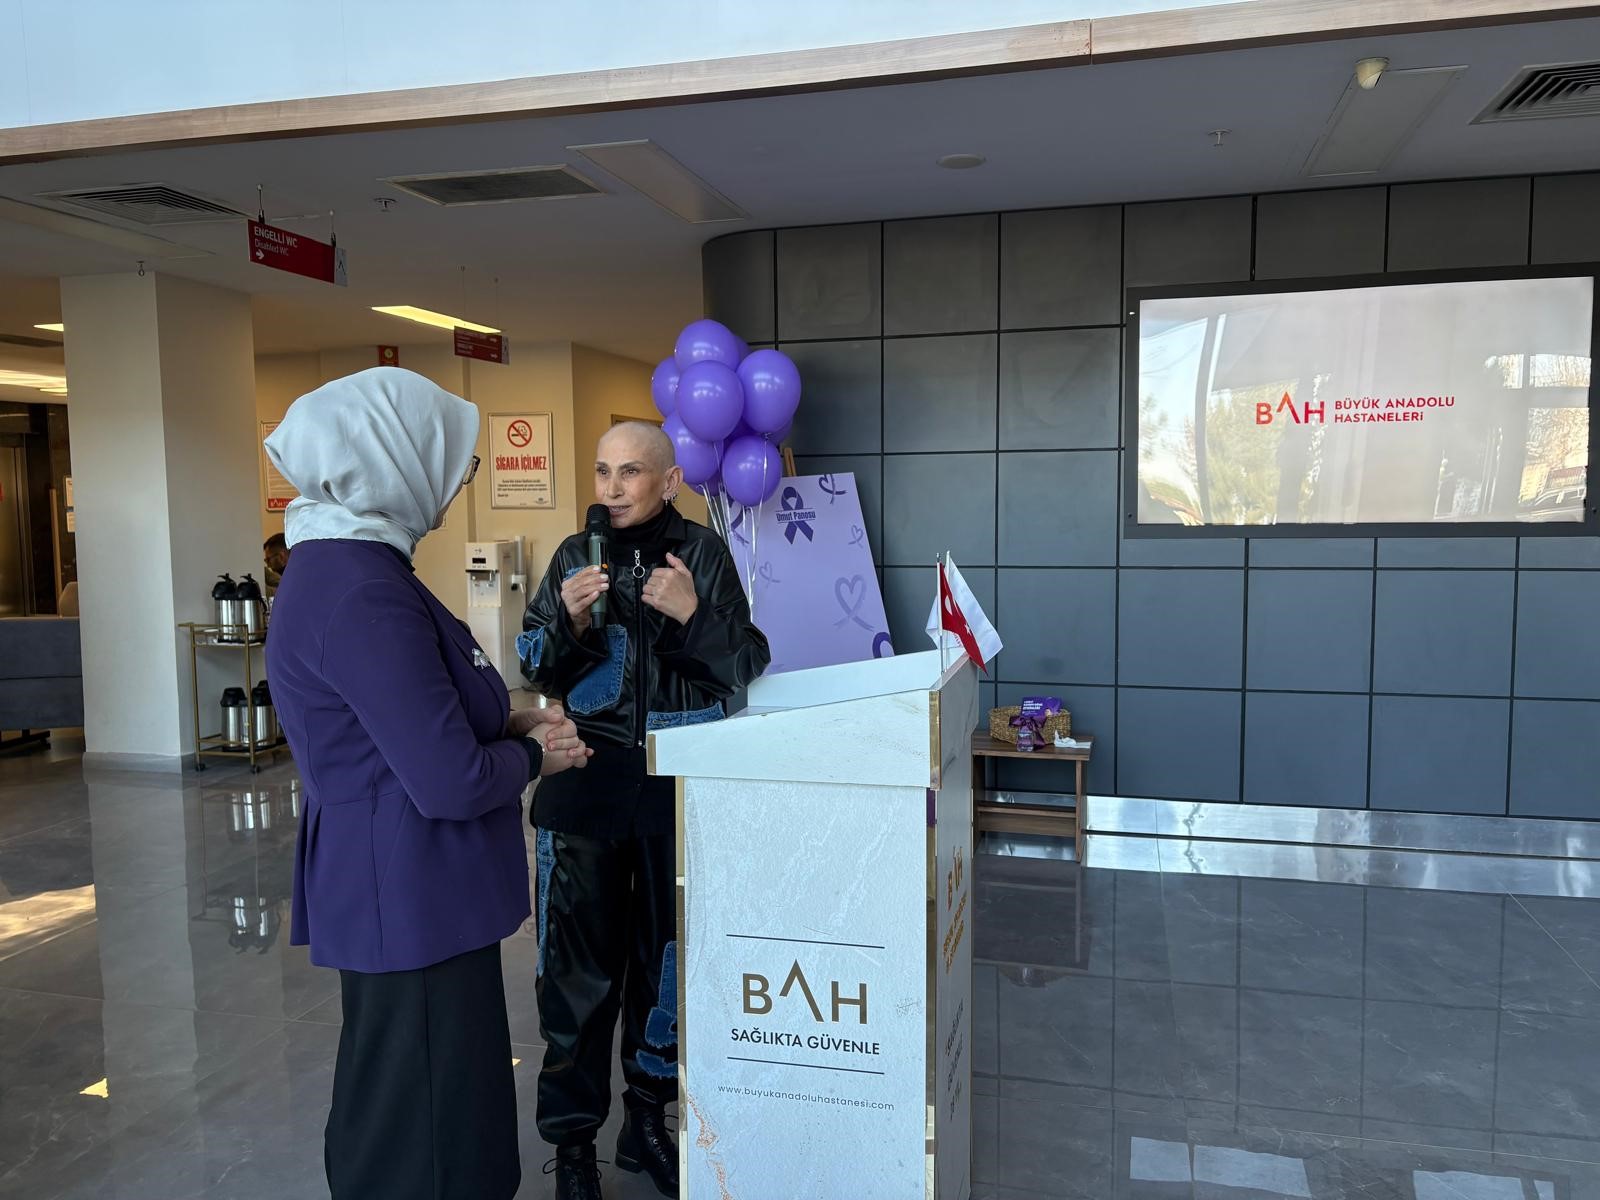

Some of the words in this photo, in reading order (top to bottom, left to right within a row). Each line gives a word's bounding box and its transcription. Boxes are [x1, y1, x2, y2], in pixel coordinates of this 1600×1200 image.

[255, 238, 279, 254] Disabled
[285, 234, 298, 248] WC
[1334, 396, 1380, 410] BÜYÜK
[1385, 396, 1455, 409] ANADOLU
[495, 454, 520, 471] SİGARA
[520, 453, 547, 472] İÇİLMEZ
[776, 512, 793, 521] Umut
[793, 511, 816, 520] Panosu
[731, 1027, 803, 1047] SAĞLIKTA
[807, 1034, 880, 1055] GÜVENLE
[718, 1085, 895, 1111] www.buyukanadoluhastanesi.com
